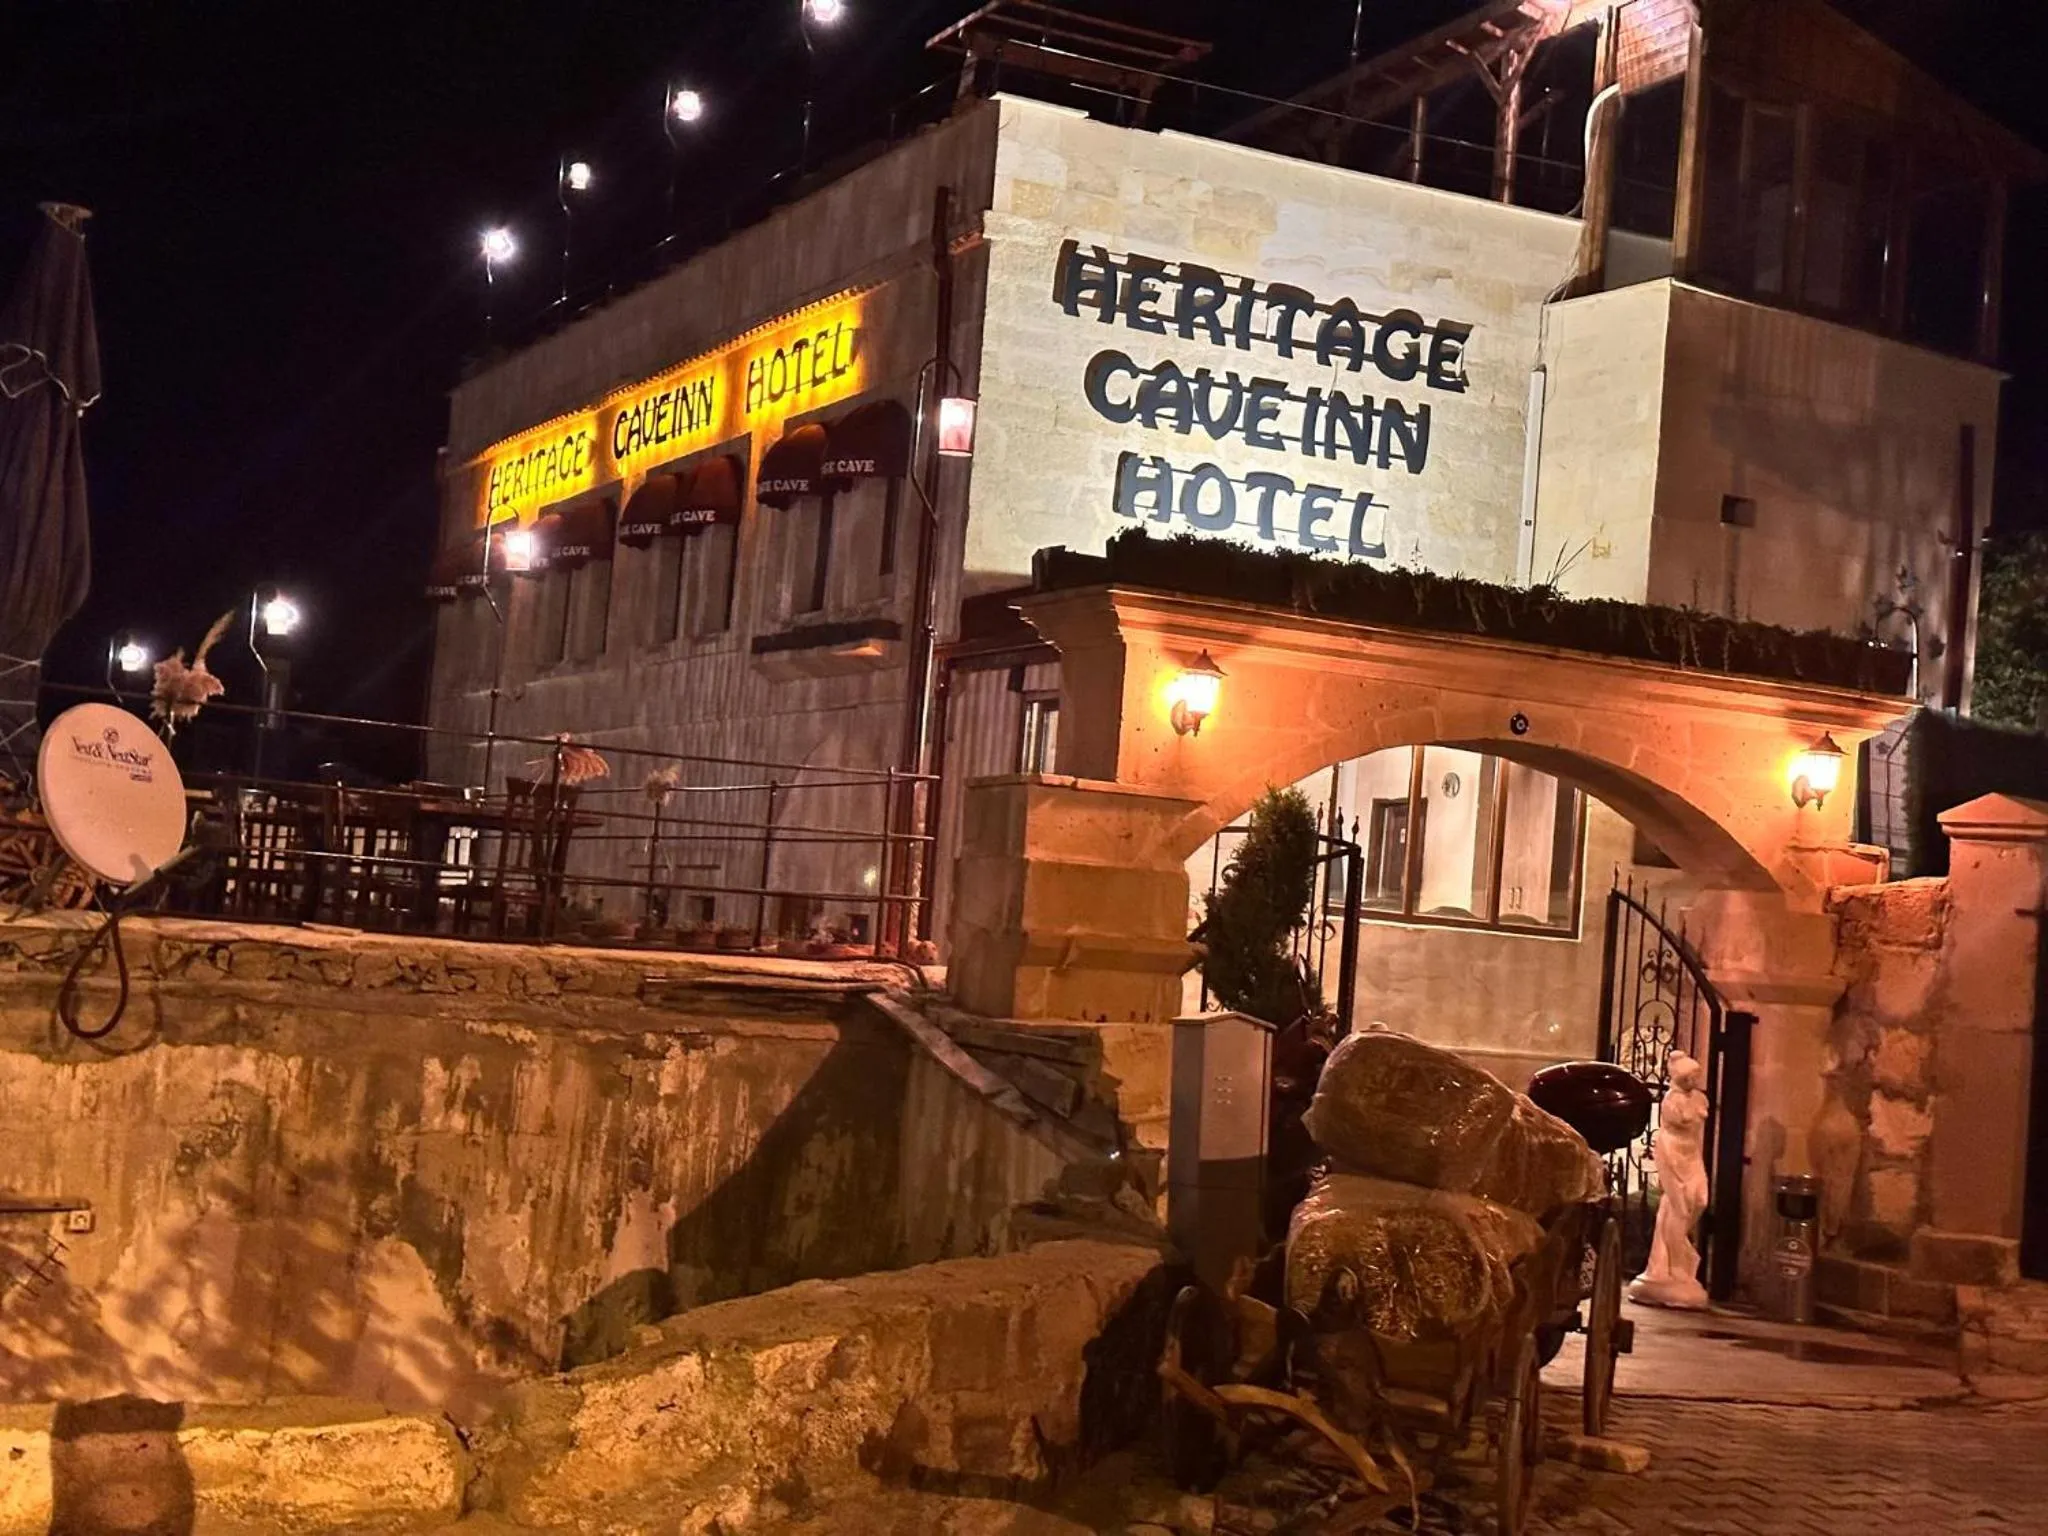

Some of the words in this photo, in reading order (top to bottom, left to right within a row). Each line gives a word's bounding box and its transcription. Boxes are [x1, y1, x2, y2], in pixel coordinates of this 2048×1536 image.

[1053, 239, 1474, 393] HERITAGE
[488, 430, 588, 509] HERITAGE
[745, 322, 847, 414] HOTEL
[837, 459, 875, 473] CAVE
[773, 479, 809, 492] CAVE
[1112, 451, 1390, 559] HOTEL
[683, 509, 717, 522] CAVE
[631, 523, 662, 535] CAVE
